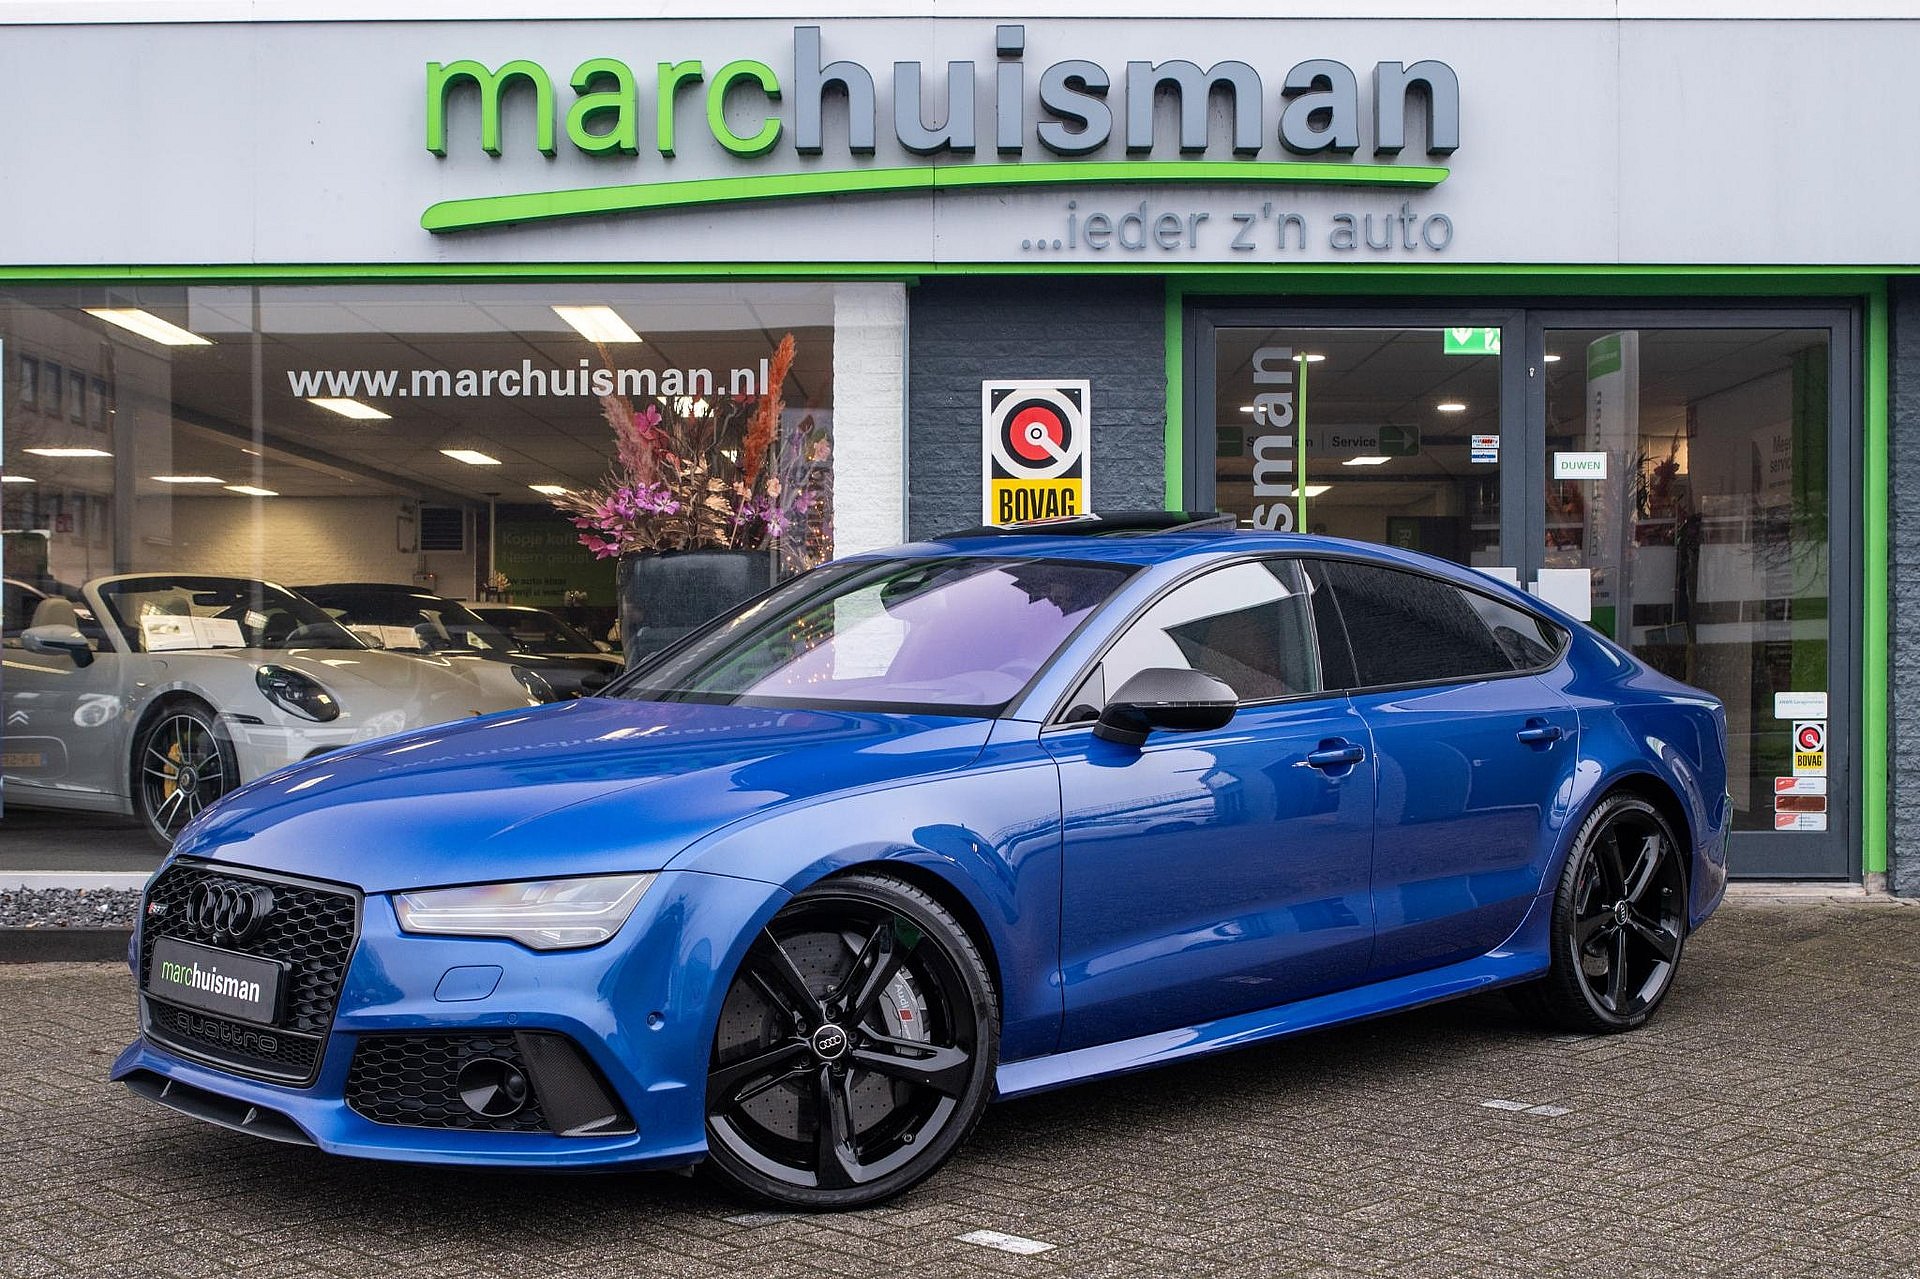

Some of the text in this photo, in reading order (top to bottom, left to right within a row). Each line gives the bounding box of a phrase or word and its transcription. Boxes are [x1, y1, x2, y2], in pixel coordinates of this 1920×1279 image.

[426, 25, 1460, 157] marchuisman
[1231, 202, 1306, 250] z'n
[1329, 200, 1454, 250] auto
[287, 358, 770, 397] www.marchuisman.nl
[1332, 436, 1377, 448] Service
[1561, 461, 1601, 470] DUWEN
[999, 488, 1075, 523] BOVAG
[1797, 754, 1822, 767] BOVAG
[161, 961, 260, 1003] marchuisman
[895, 983, 910, 1009] Audi
[177, 1011, 278, 1053] quattro
